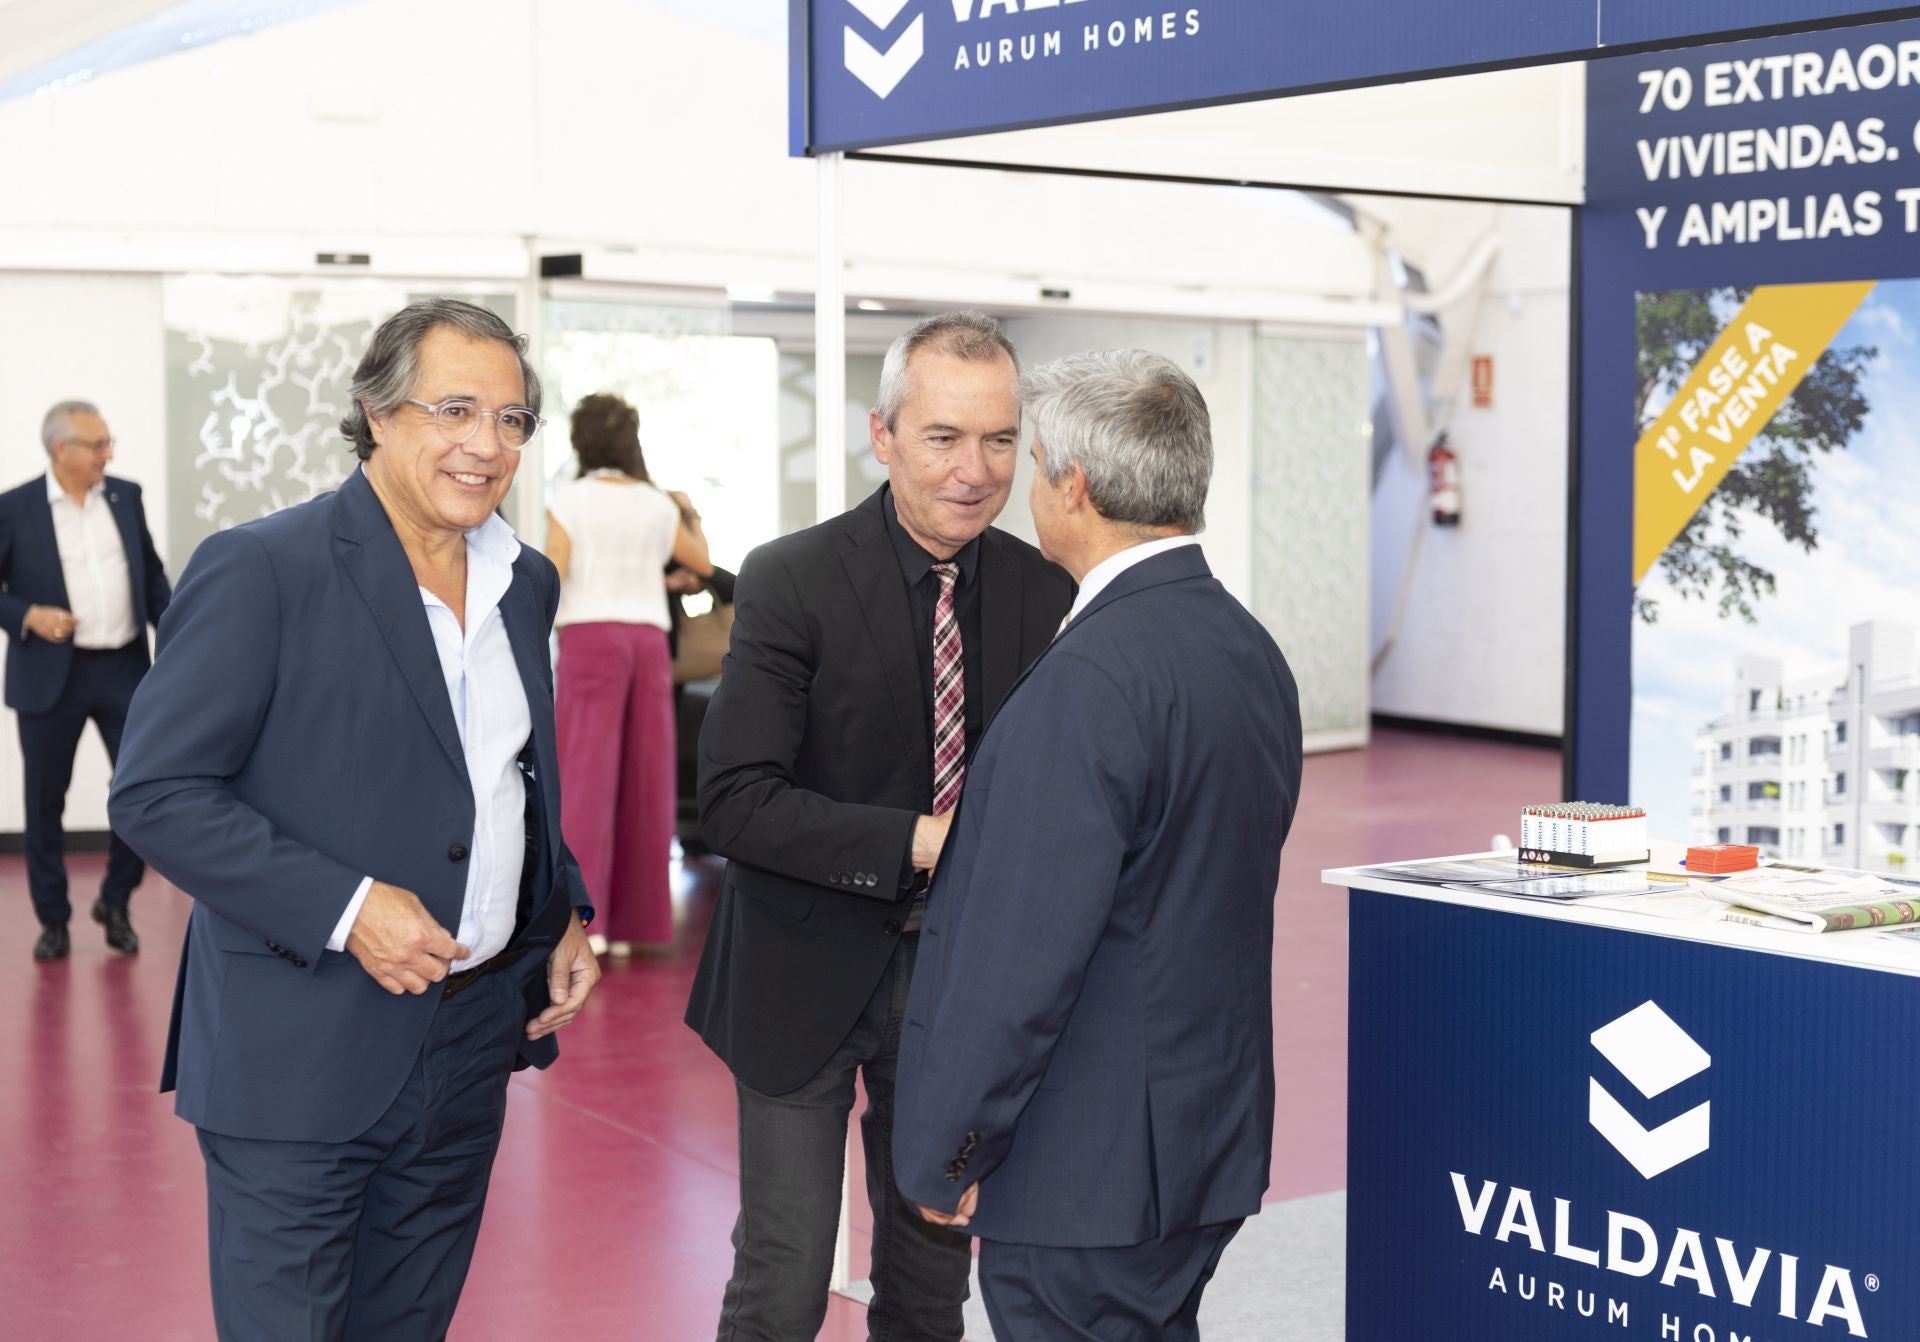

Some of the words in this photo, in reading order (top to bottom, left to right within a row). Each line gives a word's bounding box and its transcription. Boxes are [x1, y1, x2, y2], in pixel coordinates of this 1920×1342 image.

[954, 31, 1061, 71] AURUM
[1084, 9, 1201, 51] HOMES
[1637, 67, 1693, 114] 70
[1704, 40, 1920, 107] EXTRAOR
[1636, 117, 1899, 181] VIVIENDAS.
[1635, 206, 1668, 249] Y
[1676, 190, 1883, 247] AMPLIAS
[1679, 345, 1749, 433] FASE
[1744, 321, 1773, 354] A
[1672, 446, 1716, 494] LA
[1705, 342, 1798, 443] VENTA
[1488, 1266, 1629, 1328] AURUM
